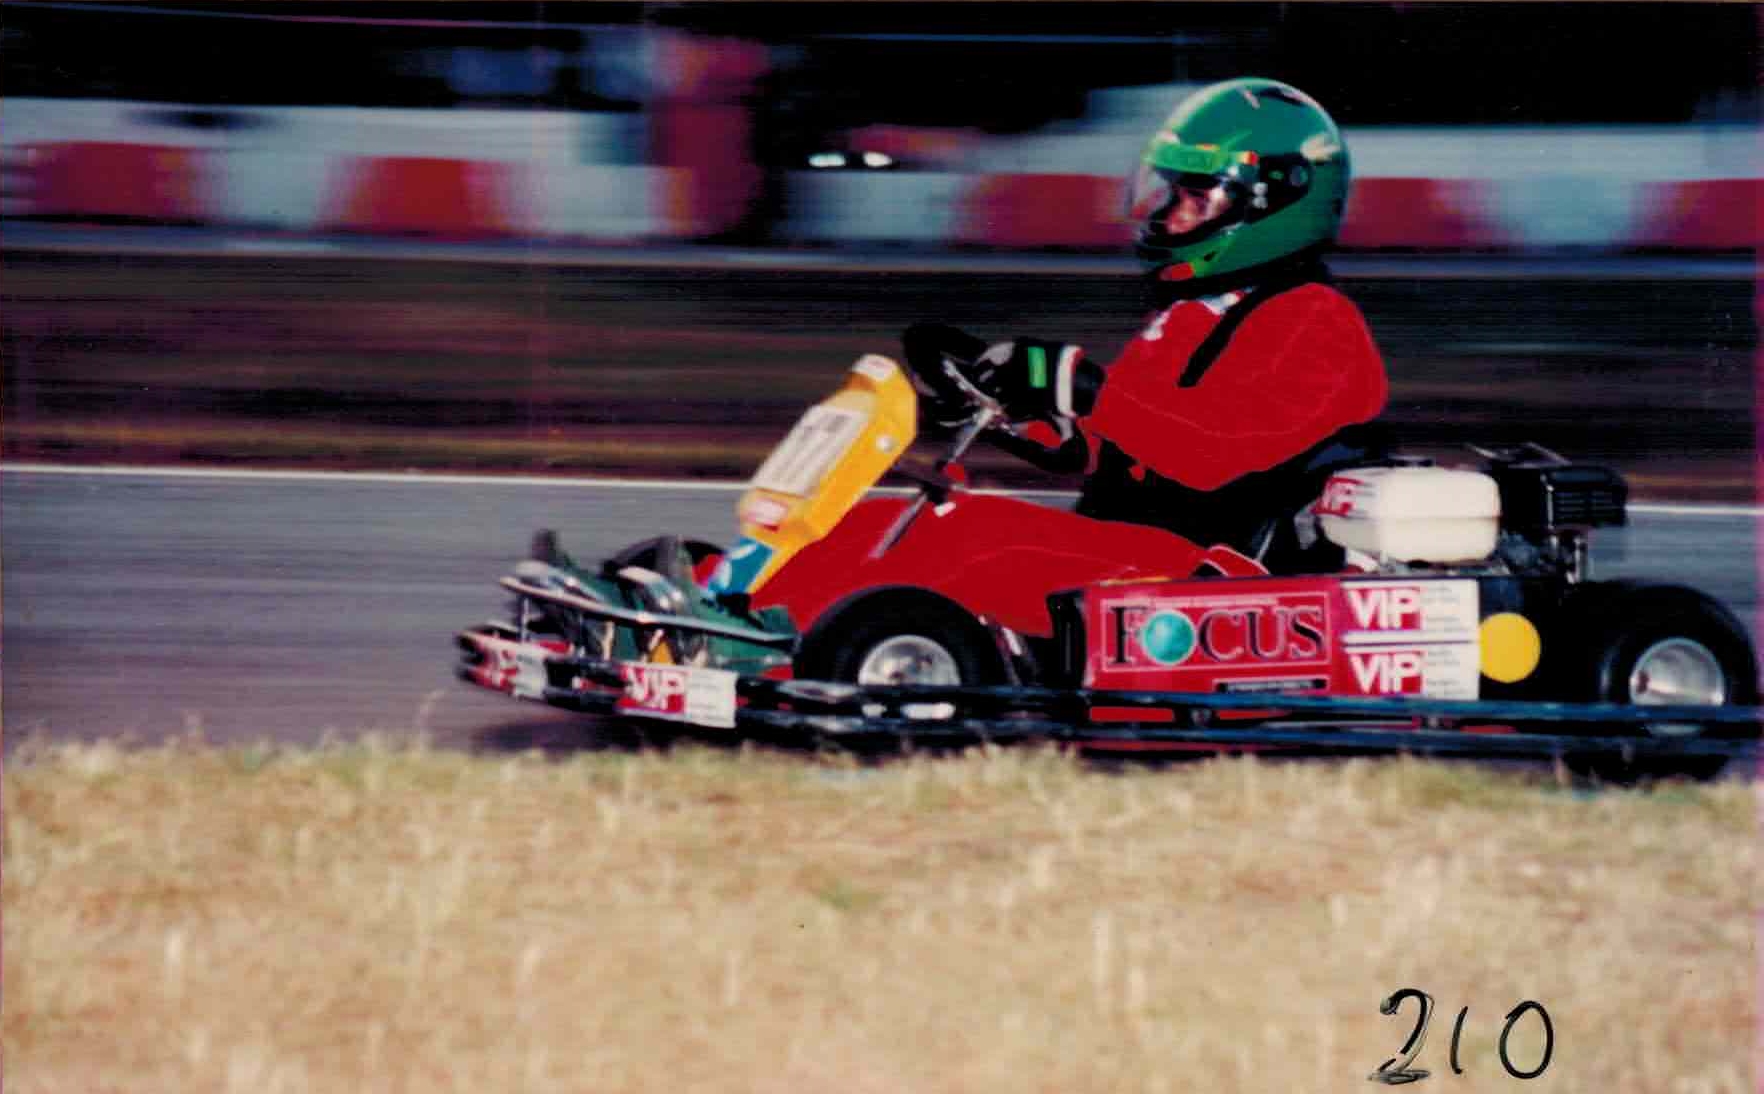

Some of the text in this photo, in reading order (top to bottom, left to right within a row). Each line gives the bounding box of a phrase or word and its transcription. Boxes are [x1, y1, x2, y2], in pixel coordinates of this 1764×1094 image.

[1347, 588, 1423, 629] VIP
[1105, 605, 1325, 665] FOCUS
[625, 665, 687, 708] VIP
[1349, 653, 1423, 694] VIP
[1368, 988, 1555, 1085] 210
